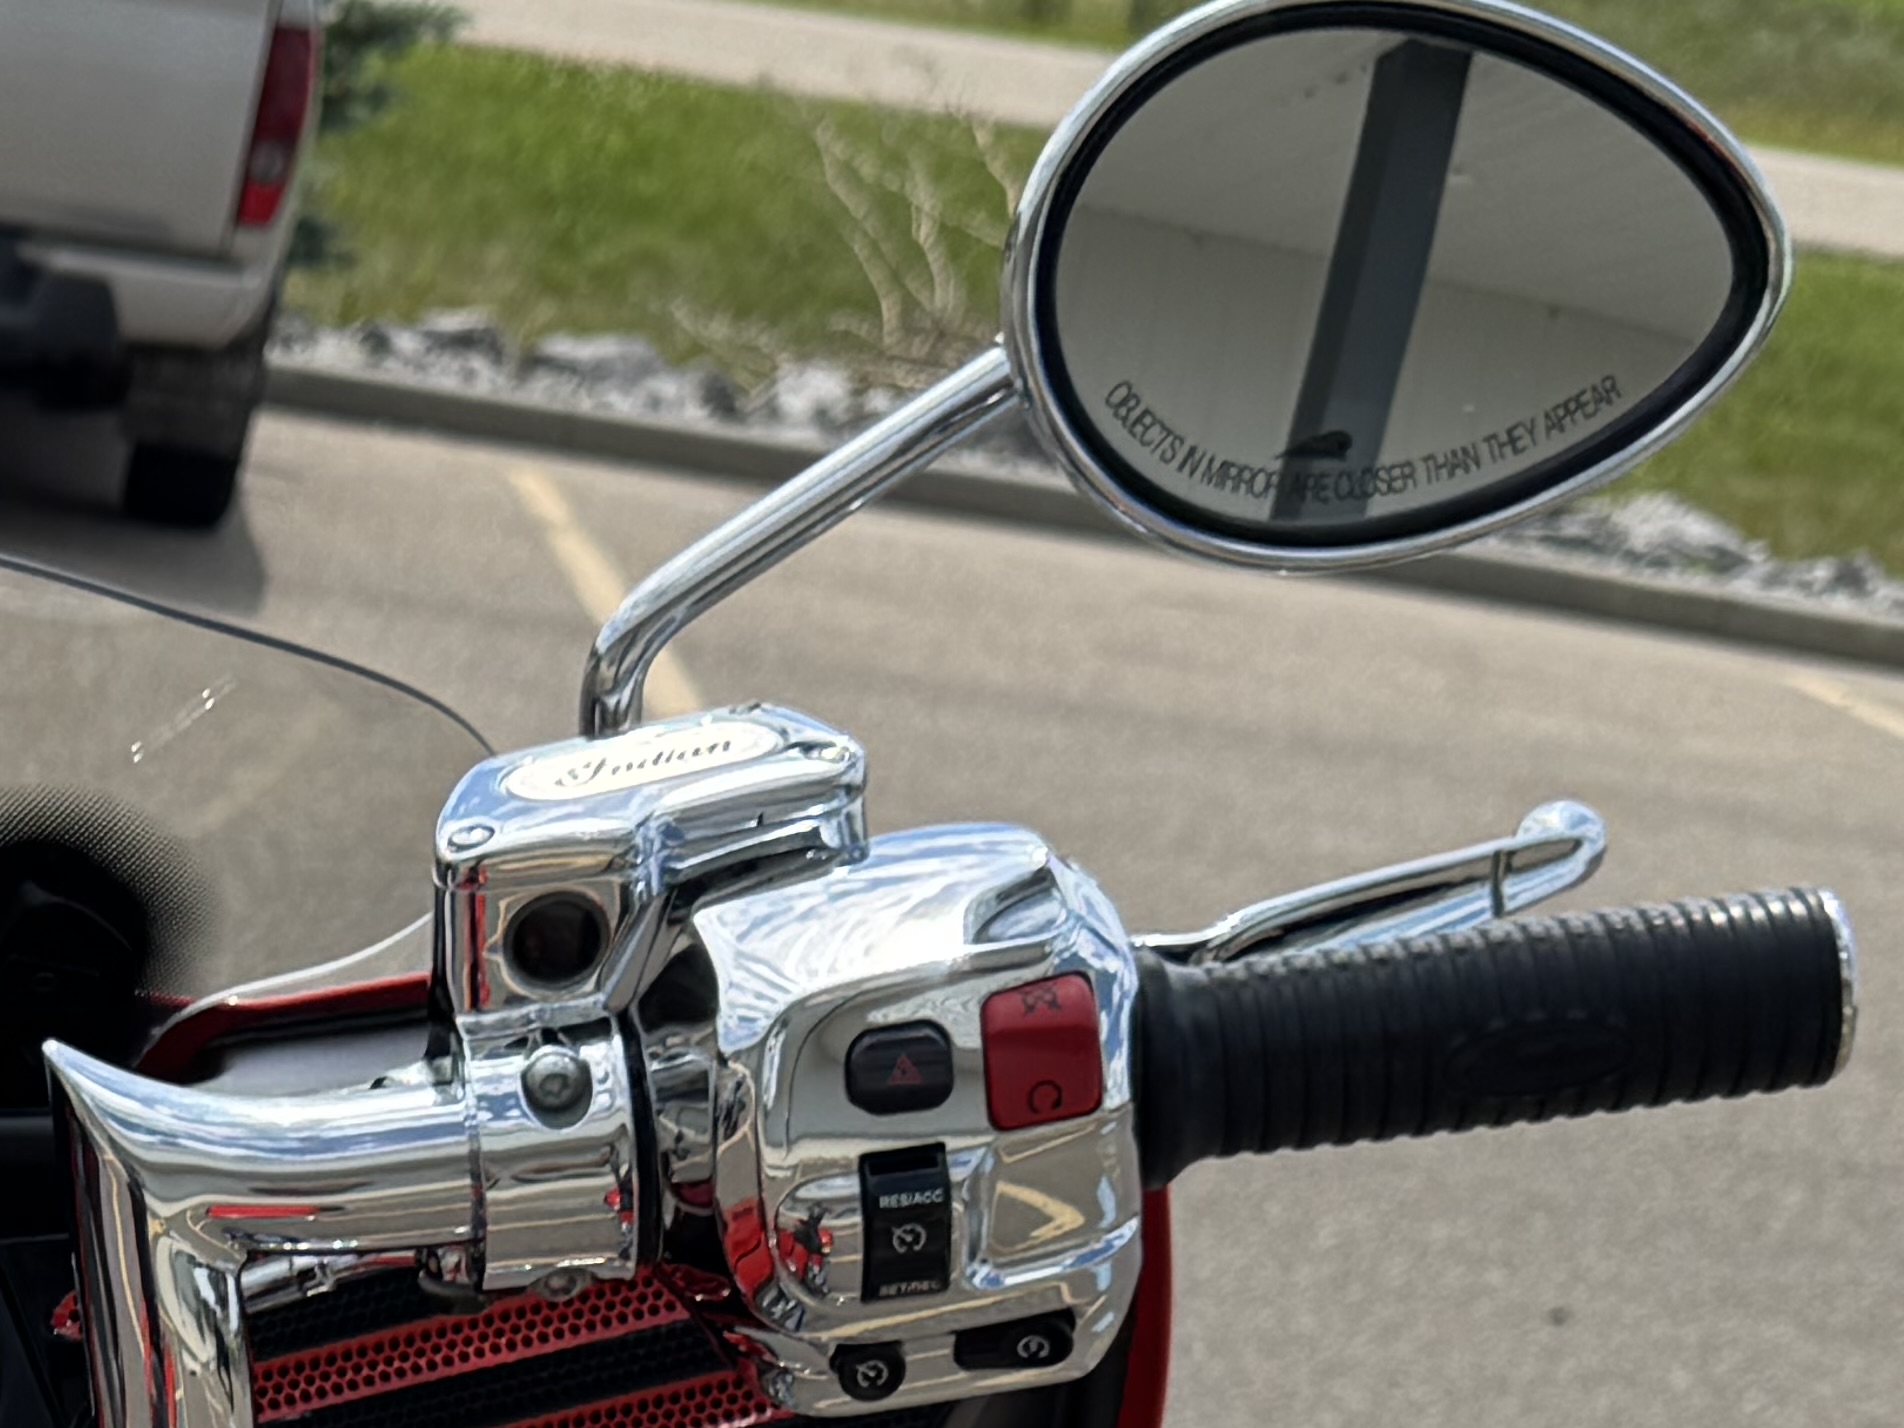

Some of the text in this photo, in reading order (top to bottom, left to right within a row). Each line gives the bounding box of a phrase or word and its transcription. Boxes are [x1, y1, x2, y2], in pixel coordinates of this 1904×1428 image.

[1105, 380, 1184, 464] OBJECTS
[1177, 445, 1205, 479] IN
[1200, 454, 1279, 499] MIRROR
[1334, 459, 1416, 500] CLOSER
[1421, 442, 1482, 485] THAN
[1482, 417, 1538, 464] THEY
[1544, 375, 1623, 439] APPEAR
